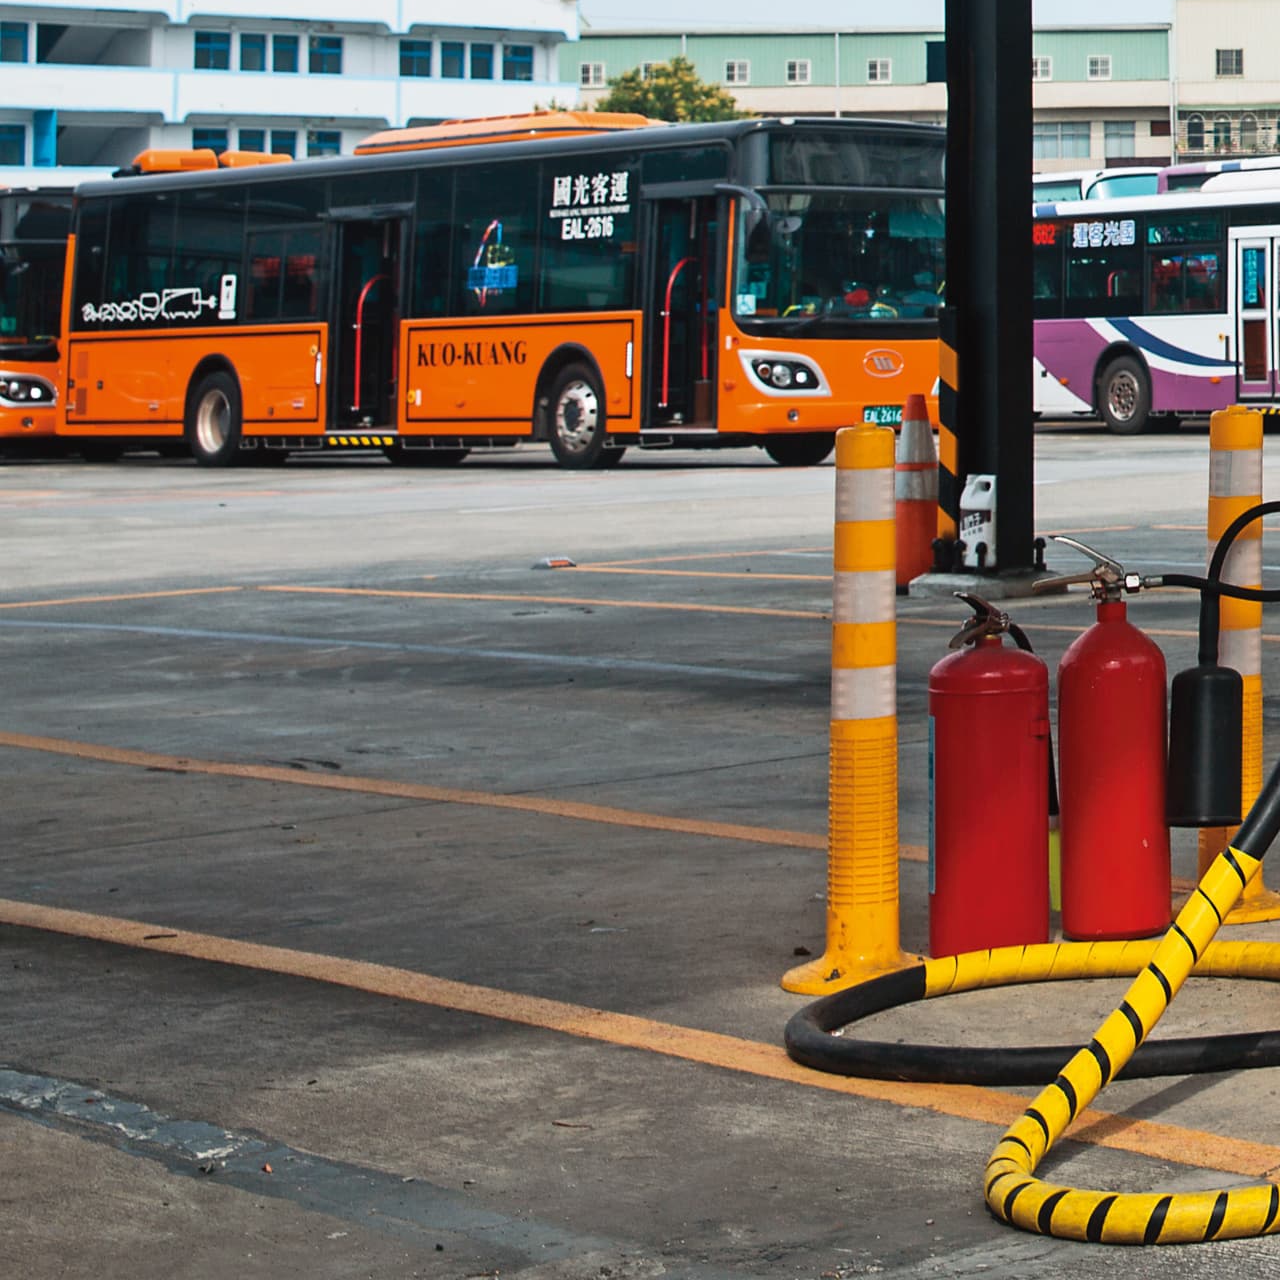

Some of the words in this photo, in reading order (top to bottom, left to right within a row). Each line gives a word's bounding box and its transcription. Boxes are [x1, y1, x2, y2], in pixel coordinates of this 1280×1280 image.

[552, 171, 629, 208] 國光客運
[417, 341, 527, 367] KUO-KUANG
